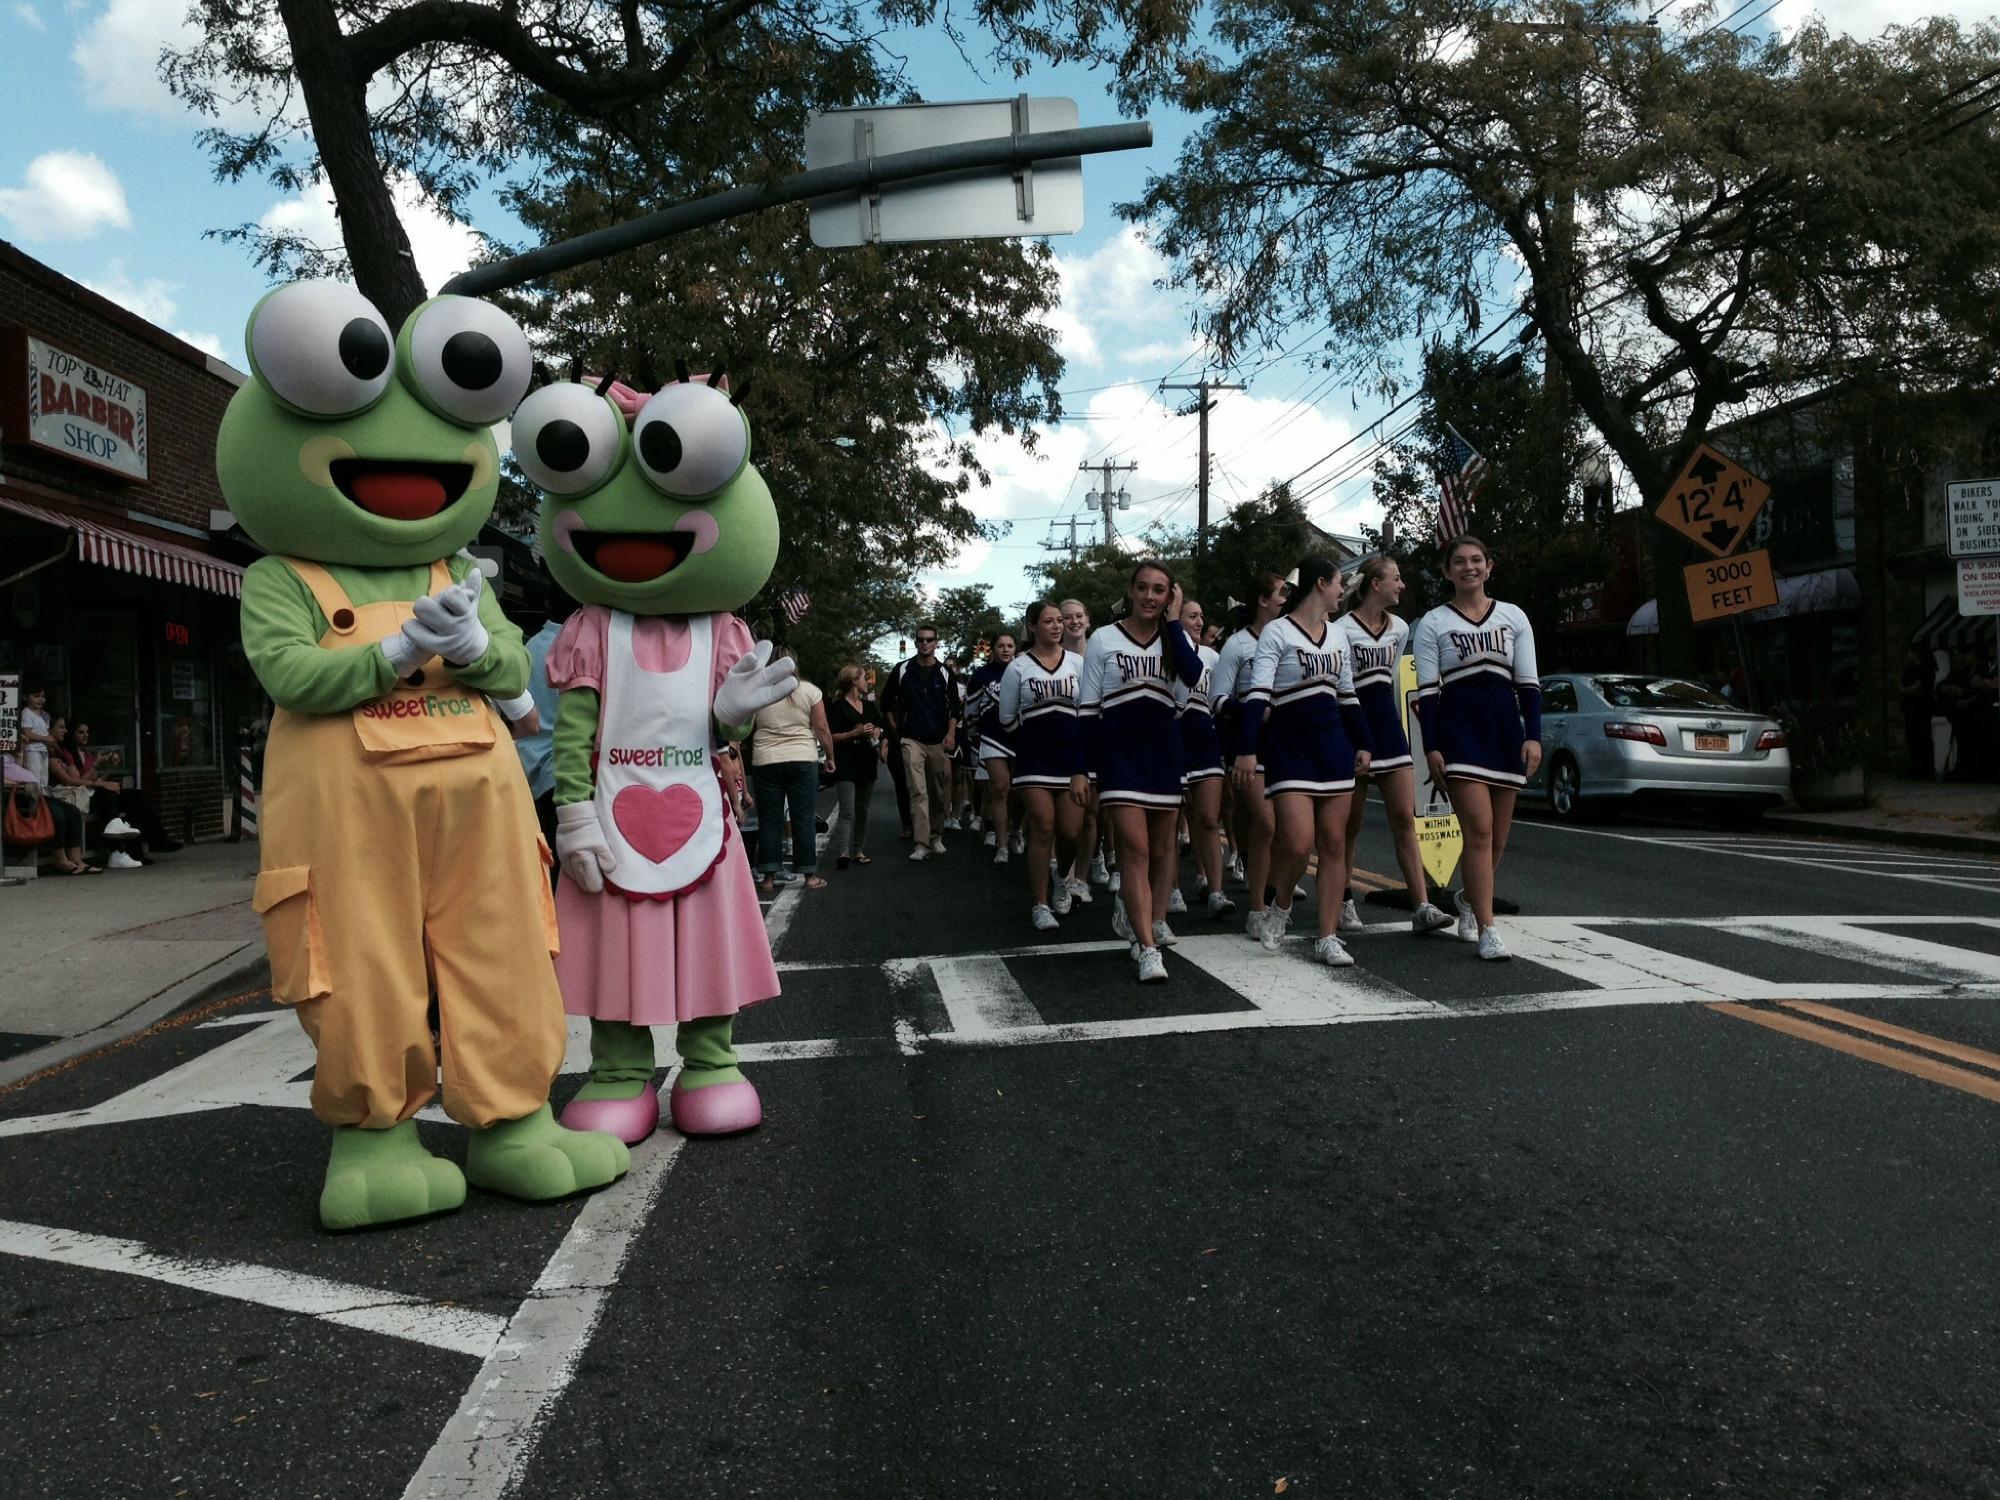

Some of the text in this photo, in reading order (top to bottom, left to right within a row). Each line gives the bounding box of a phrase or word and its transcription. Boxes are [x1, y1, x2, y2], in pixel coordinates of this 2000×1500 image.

[48, 349, 132, 402] TOP HAT
[40, 373, 136, 449] BARBER
[64, 422, 118, 460] SHOP
[1961, 486, 1993, 498] BIKERS
[1953, 500, 1977, 511] WALK
[1954, 512, 1984, 524] RIDING
[1956, 527, 1968, 538] ON
[1705, 561, 1752, 585] 3000
[1961, 562, 1974, 570] NO
[1962, 573, 1977, 581] ON
[1712, 585, 1753, 610] FEET
[166, 622, 190, 646] OPEN
[1449, 627, 1508, 661] SAYVILLE
[1116, 653, 1168, 682] SAYVILL
[1028, 675, 1075, 703] SAYVILLE
[362, 695, 474, 720] sweetFrog
[0, 719, 18, 729] BER
[608, 745, 703, 767] sweetFrog
[1424, 818, 1451, 829] WITHIN
